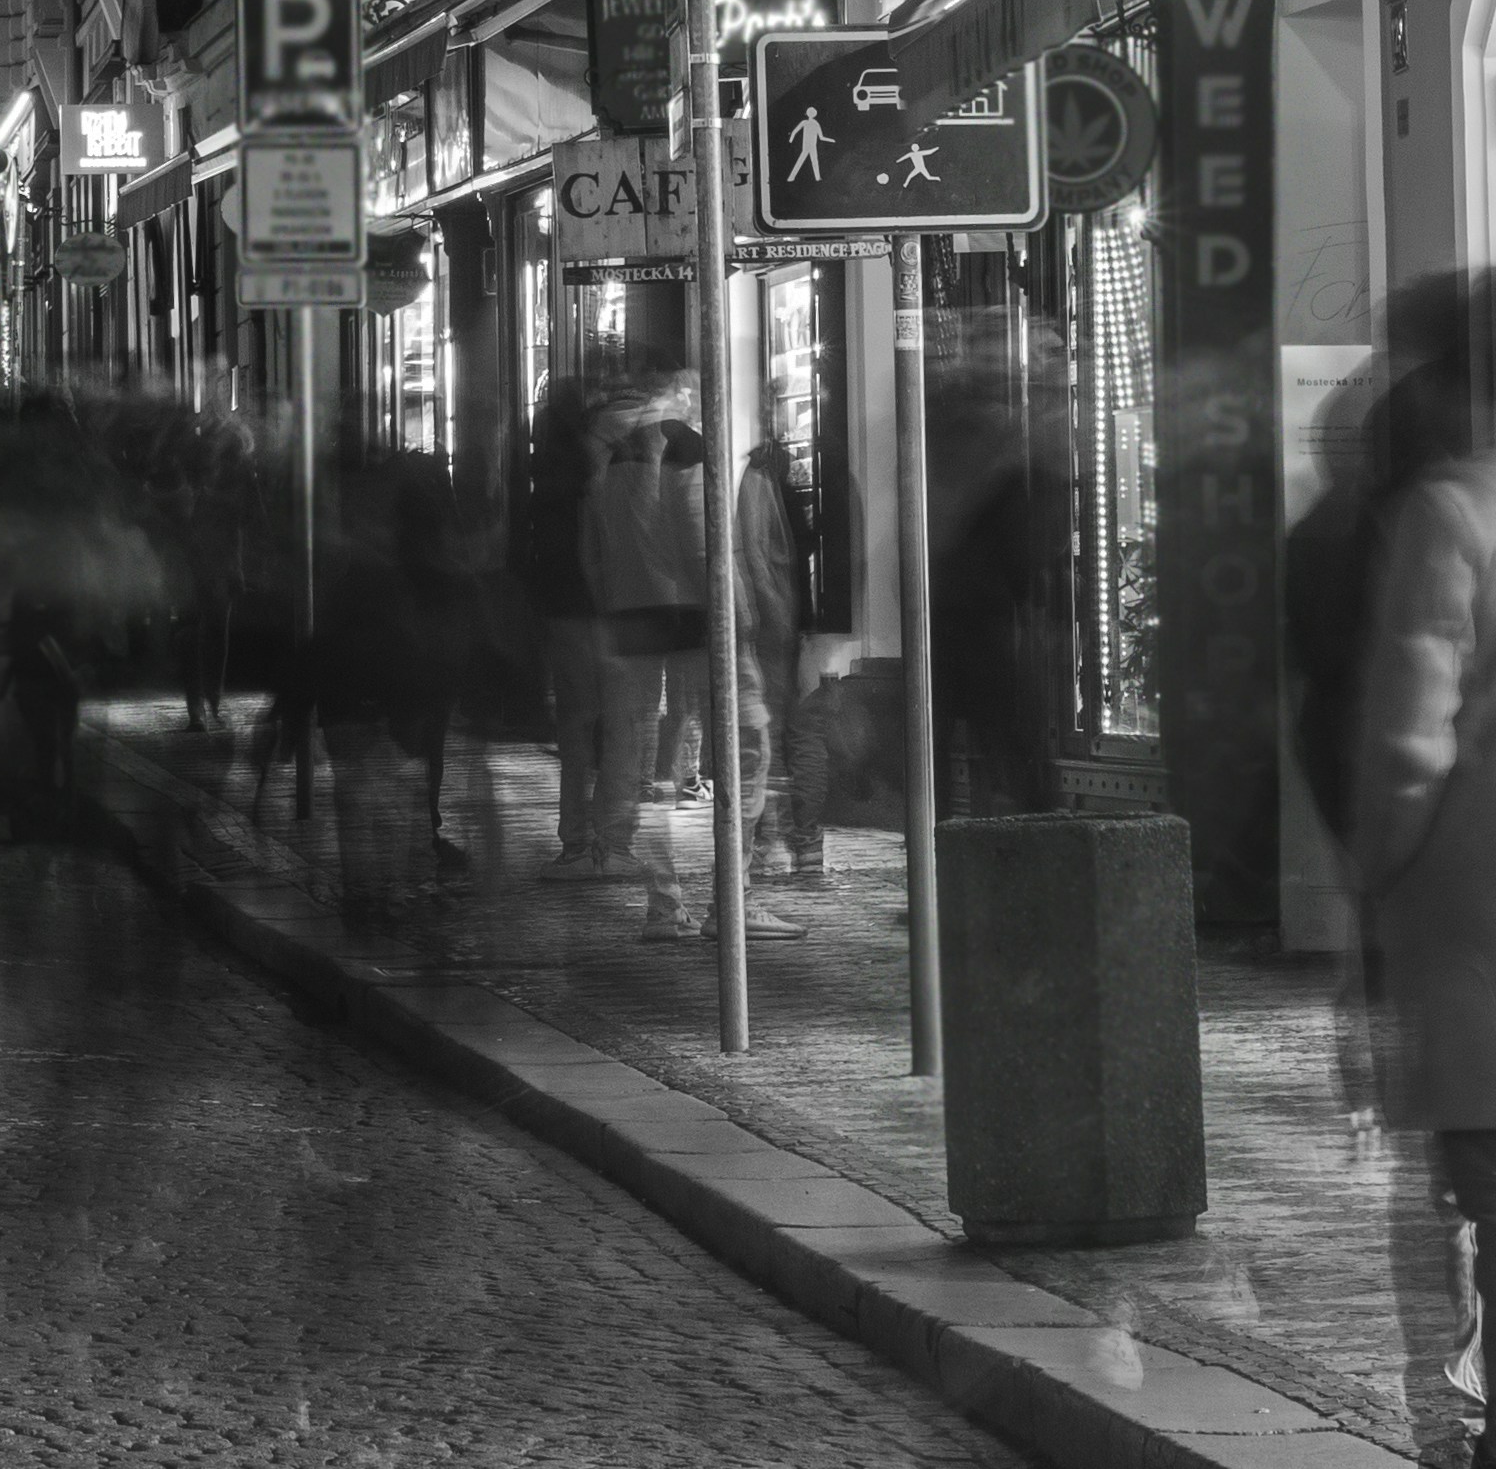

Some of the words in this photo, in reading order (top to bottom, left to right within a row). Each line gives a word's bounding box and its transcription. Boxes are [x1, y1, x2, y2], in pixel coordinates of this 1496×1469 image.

[1077, 53, 1138, 98] SHOP
[765, 243, 848, 259] RESIDENCE
[591, 264, 671, 283] MOSTECKÁ
[675, 264, 694, 280] 14
[1297, 378, 1348, 387] Mostecká
[1353, 378, 1364, 387] 12
